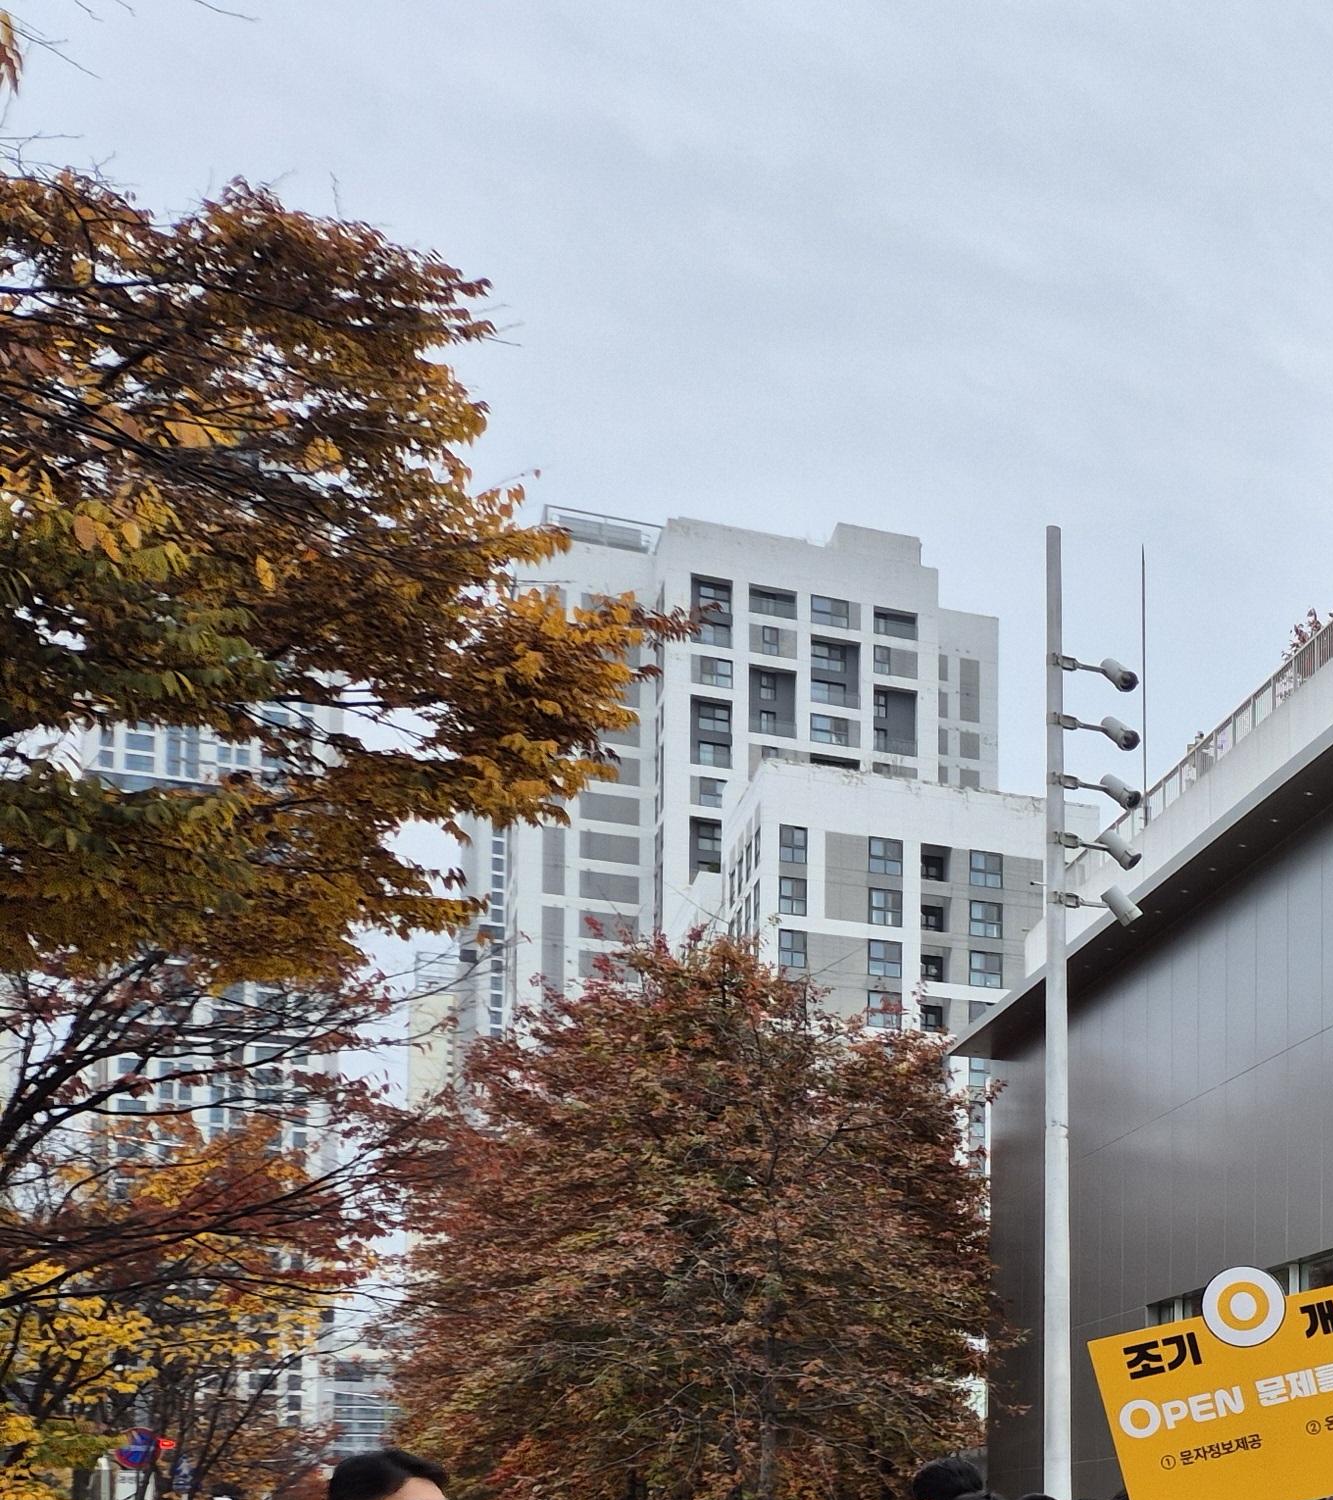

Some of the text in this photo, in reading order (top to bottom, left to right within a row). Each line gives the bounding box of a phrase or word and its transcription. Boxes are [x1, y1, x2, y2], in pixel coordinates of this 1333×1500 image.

[1123, 1331, 1203, 1380] 조기
[1217, 1281, 1270, 1331] O
[1119, 1385, 1245, 1439] OPEN
[1180, 1433, 1263, 1466] 문자정보제공
